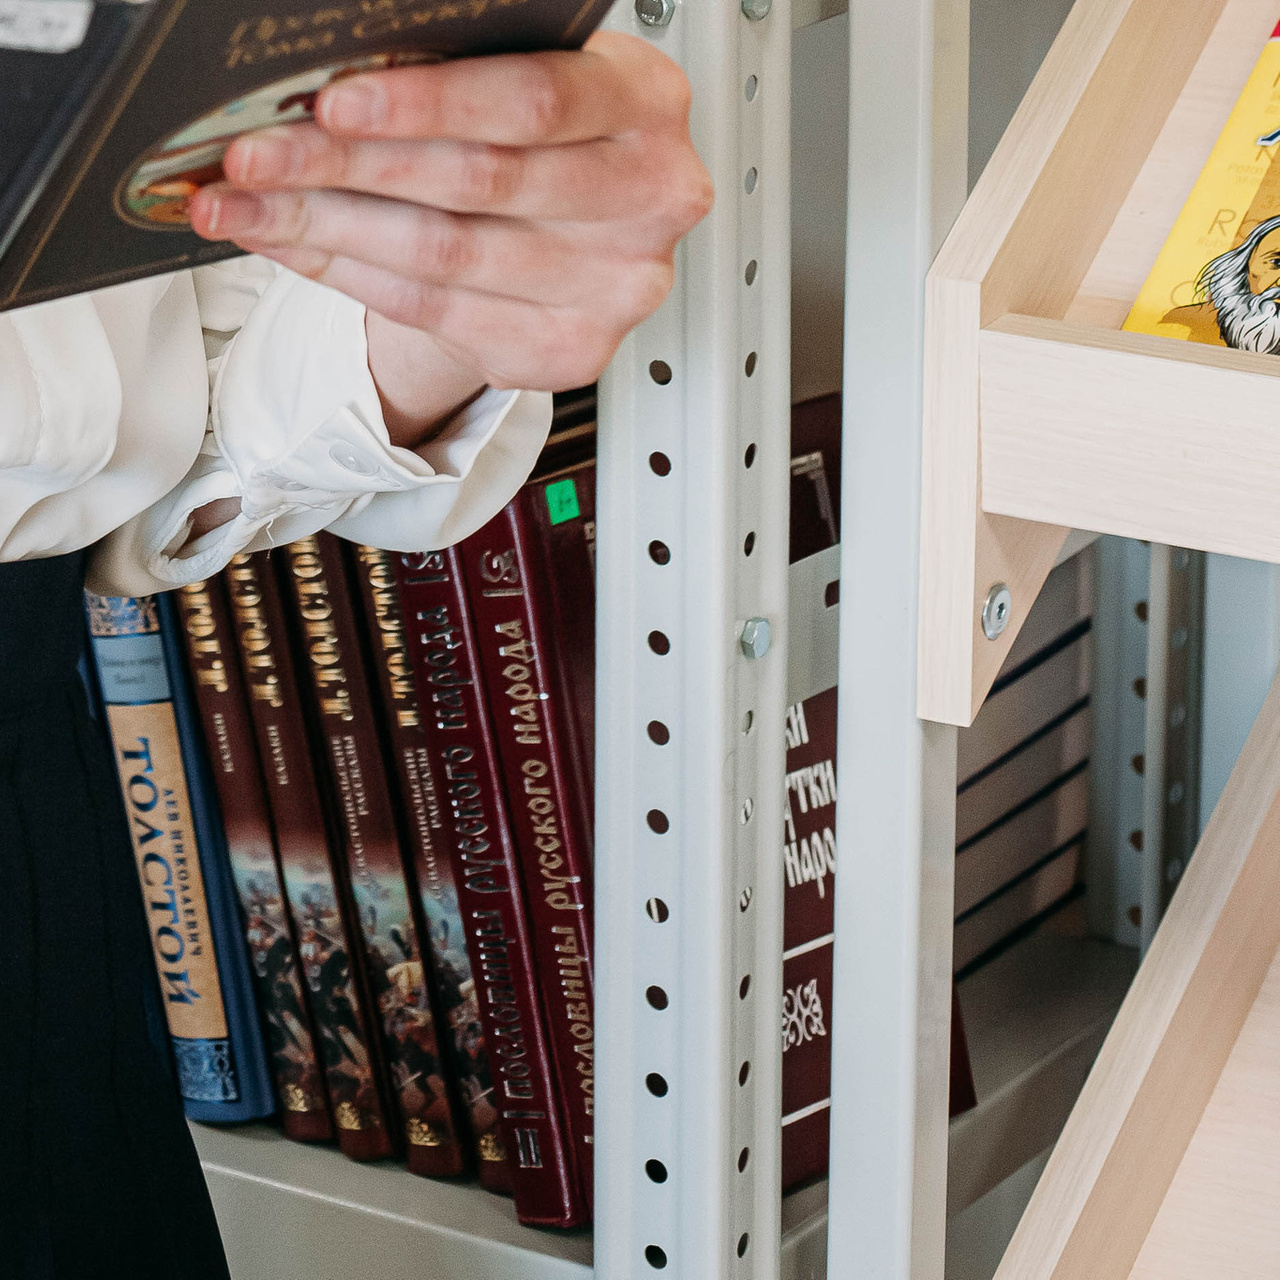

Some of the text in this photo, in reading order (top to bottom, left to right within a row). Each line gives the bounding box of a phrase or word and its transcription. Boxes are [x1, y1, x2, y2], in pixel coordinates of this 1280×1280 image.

[416, 606, 472, 730] народа
[494, 619, 550, 744] народа
[120, 736, 201, 1006] ТОЛСТОЙ
[521, 759, 584, 911] русского
